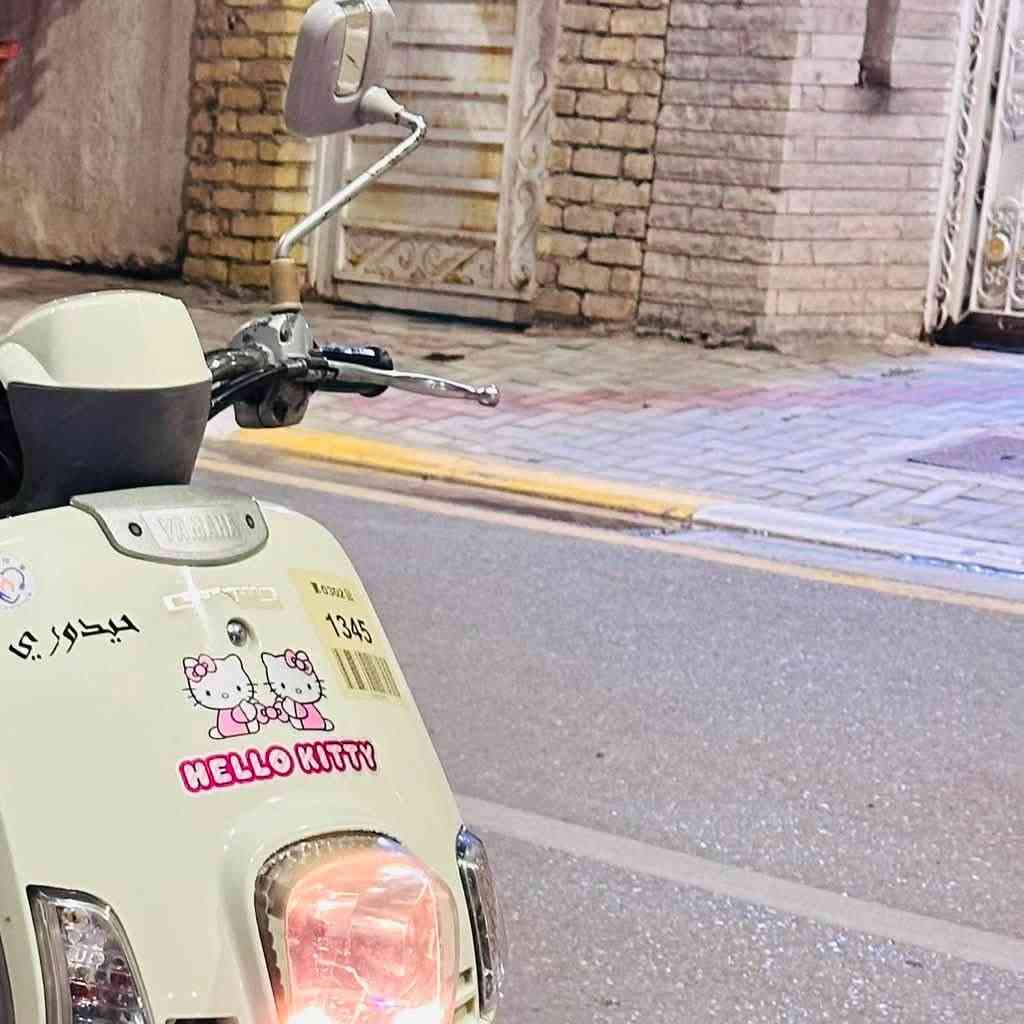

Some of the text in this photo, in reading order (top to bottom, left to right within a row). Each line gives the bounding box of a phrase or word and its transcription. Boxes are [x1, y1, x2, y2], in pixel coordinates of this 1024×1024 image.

[326, 613, 373, 644] 1345
[179, 740, 377, 793] HELLO KITTY
